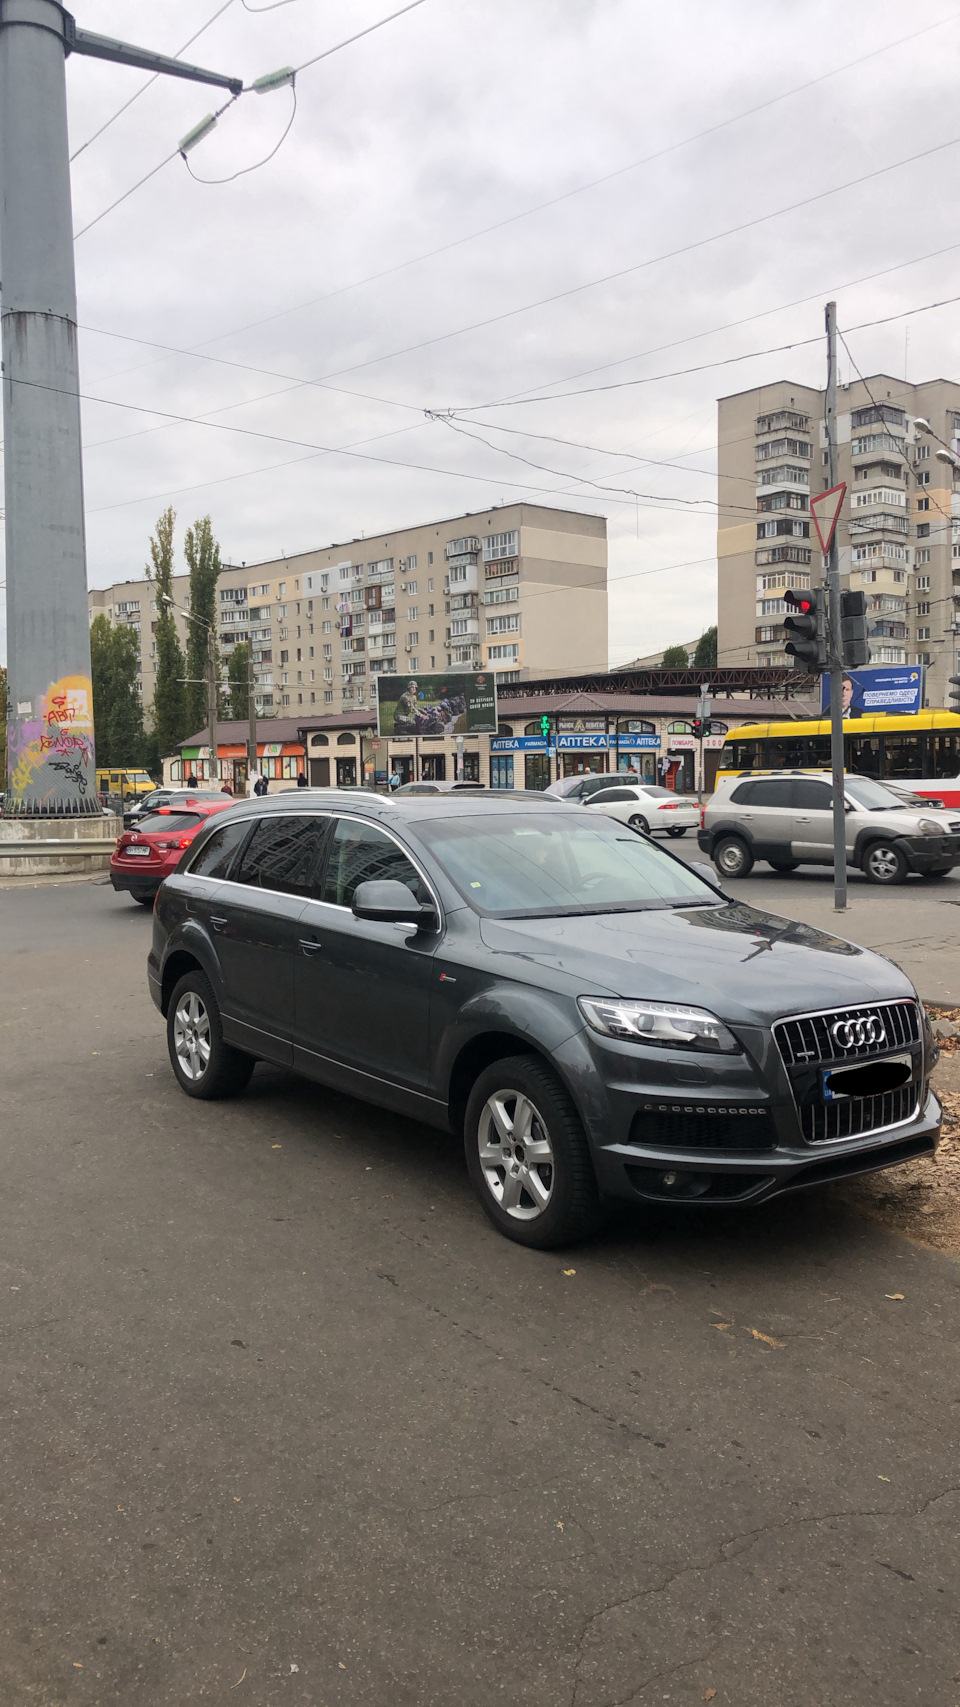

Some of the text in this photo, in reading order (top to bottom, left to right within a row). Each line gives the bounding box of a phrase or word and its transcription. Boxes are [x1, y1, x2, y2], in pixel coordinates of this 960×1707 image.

[898, 689, 916, 697] ОДЕСІ
[866, 697, 914, 705] СПРАВЕДЛИВІСТЬ
[492, 739, 519, 750] АПТЕКА
[558, 736, 607, 747] АПТЕКА
[636, 737, 661, 746] АПТЕКА
